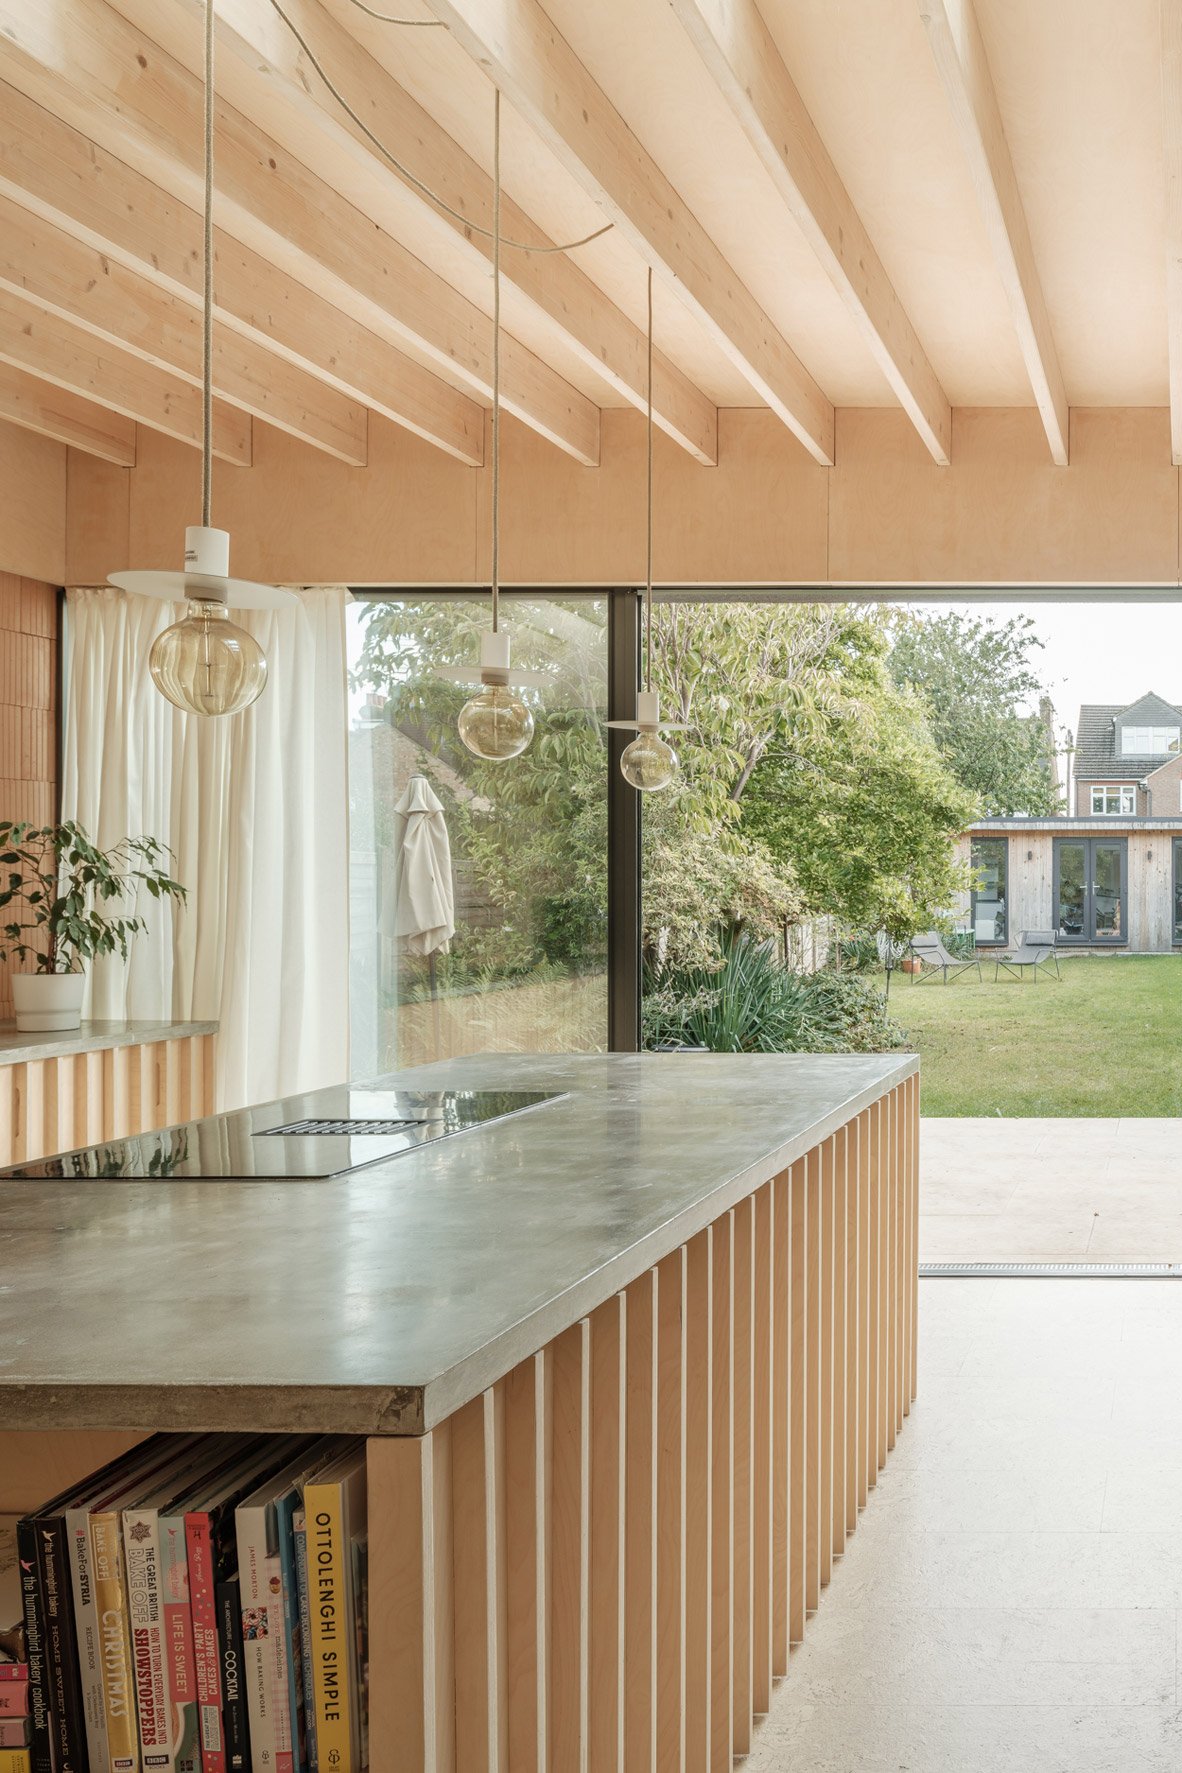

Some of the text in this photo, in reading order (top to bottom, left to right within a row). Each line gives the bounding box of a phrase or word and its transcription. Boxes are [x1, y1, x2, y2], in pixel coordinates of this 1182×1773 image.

[44, 1542, 59, 1616] the hummingbird bakery
[76, 1528, 90, 1606] #BakeForSYRIA
[96, 1527, 108, 1578] BAKE OFF
[296, 1534, 305, 1583] COMPENDIUM
[316, 1513, 336, 1640] OTTOLENGHI
[128, 1548, 148, 1622] BAKE OFF
[146, 1547, 158, 1622] THE GREAT BRITISH
[24, 1576, 48, 1730] the hummingbird bakery cookbook
[52, 1626, 60, 1662] HOME
[86, 1626, 96, 1670] RECIPE BOOK
[102, 1610, 128, 1717] CHRISTMAS
[172, 1614, 188, 1694] LIFE IS SWEET
[194, 1622, 208, 1702] CHILDREN'S PARTY
[205, 1628, 216, 1658] BAKES
[276, 1636, 284, 1679] madeleines
[301, 1614, 310, 1657] DECORATING
[56, 1668, 65, 1714] SWEET
[134, 1628, 157, 1746] SHOWSTOPPERS
[150, 1627, 168, 1744] HOW TO TURN EVERYDAY BAKES INTO
[207, 1666, 218, 1696] CAKES
[225, 1651, 238, 1701] COCKTAIL
[304, 1658, 312, 1700] TECHNIQUES
[322, 1652, 340, 1720] SIMPLE
[60, 1718, 68, 1756] HOME
